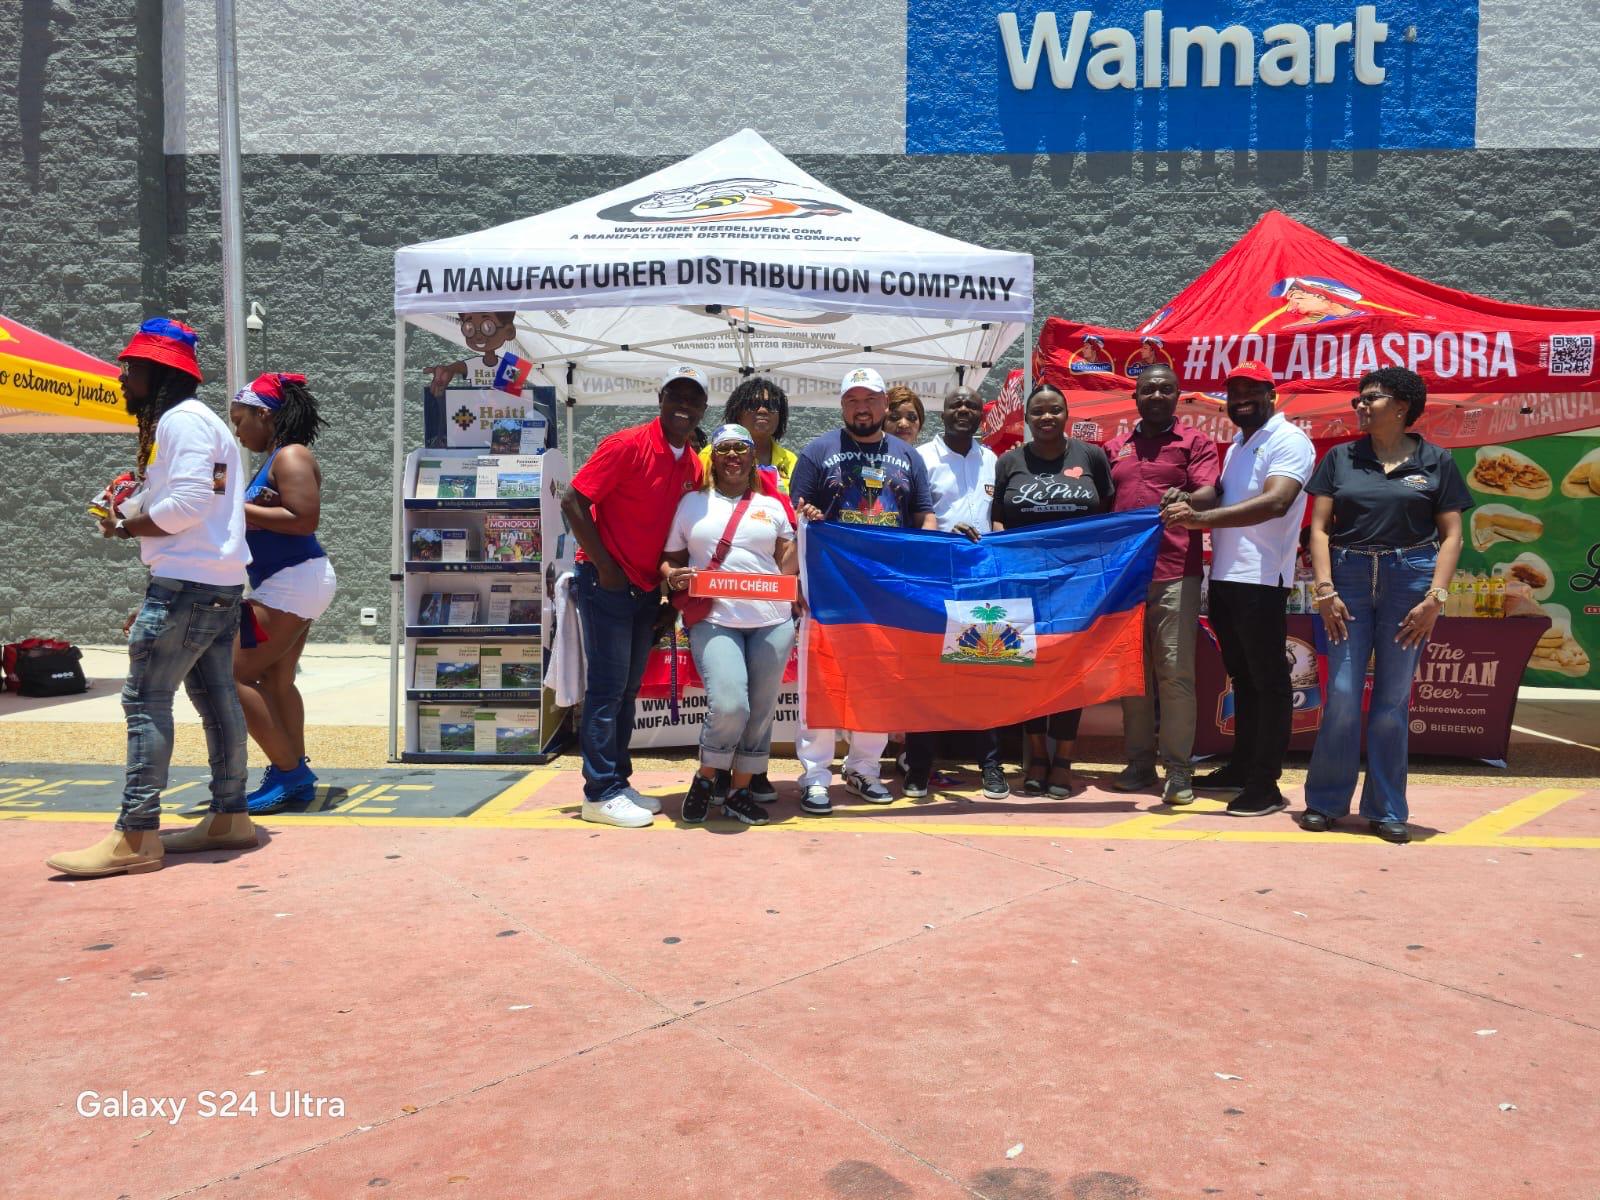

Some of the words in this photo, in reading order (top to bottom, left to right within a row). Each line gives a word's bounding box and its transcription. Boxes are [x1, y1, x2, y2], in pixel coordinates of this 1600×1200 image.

[998, 5, 1388, 90] Walmart
[795, 234, 861, 242] COMPANY
[416, 269, 433, 293] A
[443, 260, 667, 293] MANUFACTURER
[677, 258, 870, 293] DISTRIBUTION
[880, 270, 1016, 302] COMPANY
[1183, 330, 1518, 381] #KOLADIASPORA
[13, 368, 74, 396] estamos
[74, 378, 119, 406] juntos
[480, 406, 526, 419] Haiti
[824, 451, 862, 468] HAPPY
[863, 453, 910, 471] HAITIAN
[1012, 483, 1048, 505] La
[1046, 482, 1095, 499] Paix
[490, 520, 538, 529] MONOPOLY
[709, 578, 738, 590] AYITI
[740, 577, 779, 592] CHÉRIE
[1427, 642, 1465, 660] The
[1413, 660, 1499, 687] AITIAN
[1418, 683, 1463, 700] Beer
[1430, 723, 1484, 734] BIEREEWO
